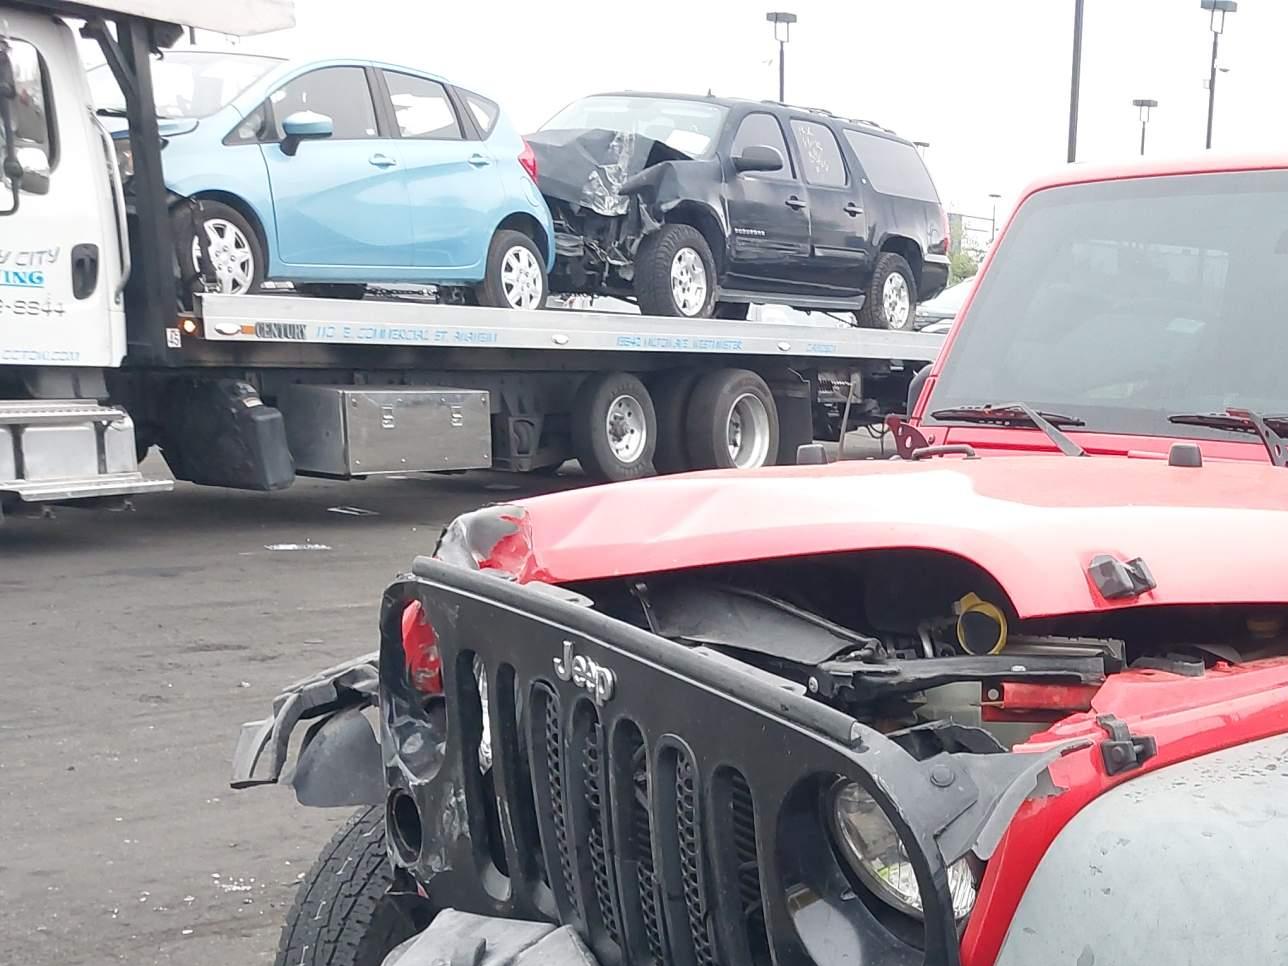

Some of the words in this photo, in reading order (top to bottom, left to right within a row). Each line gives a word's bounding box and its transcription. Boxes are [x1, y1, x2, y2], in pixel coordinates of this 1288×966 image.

[16, 246, 60, 266] CITY
[0, 270, 45, 285] ING
[255, 322, 307, 340] CENTURY
[553, 640, 617, 707] Jeep
